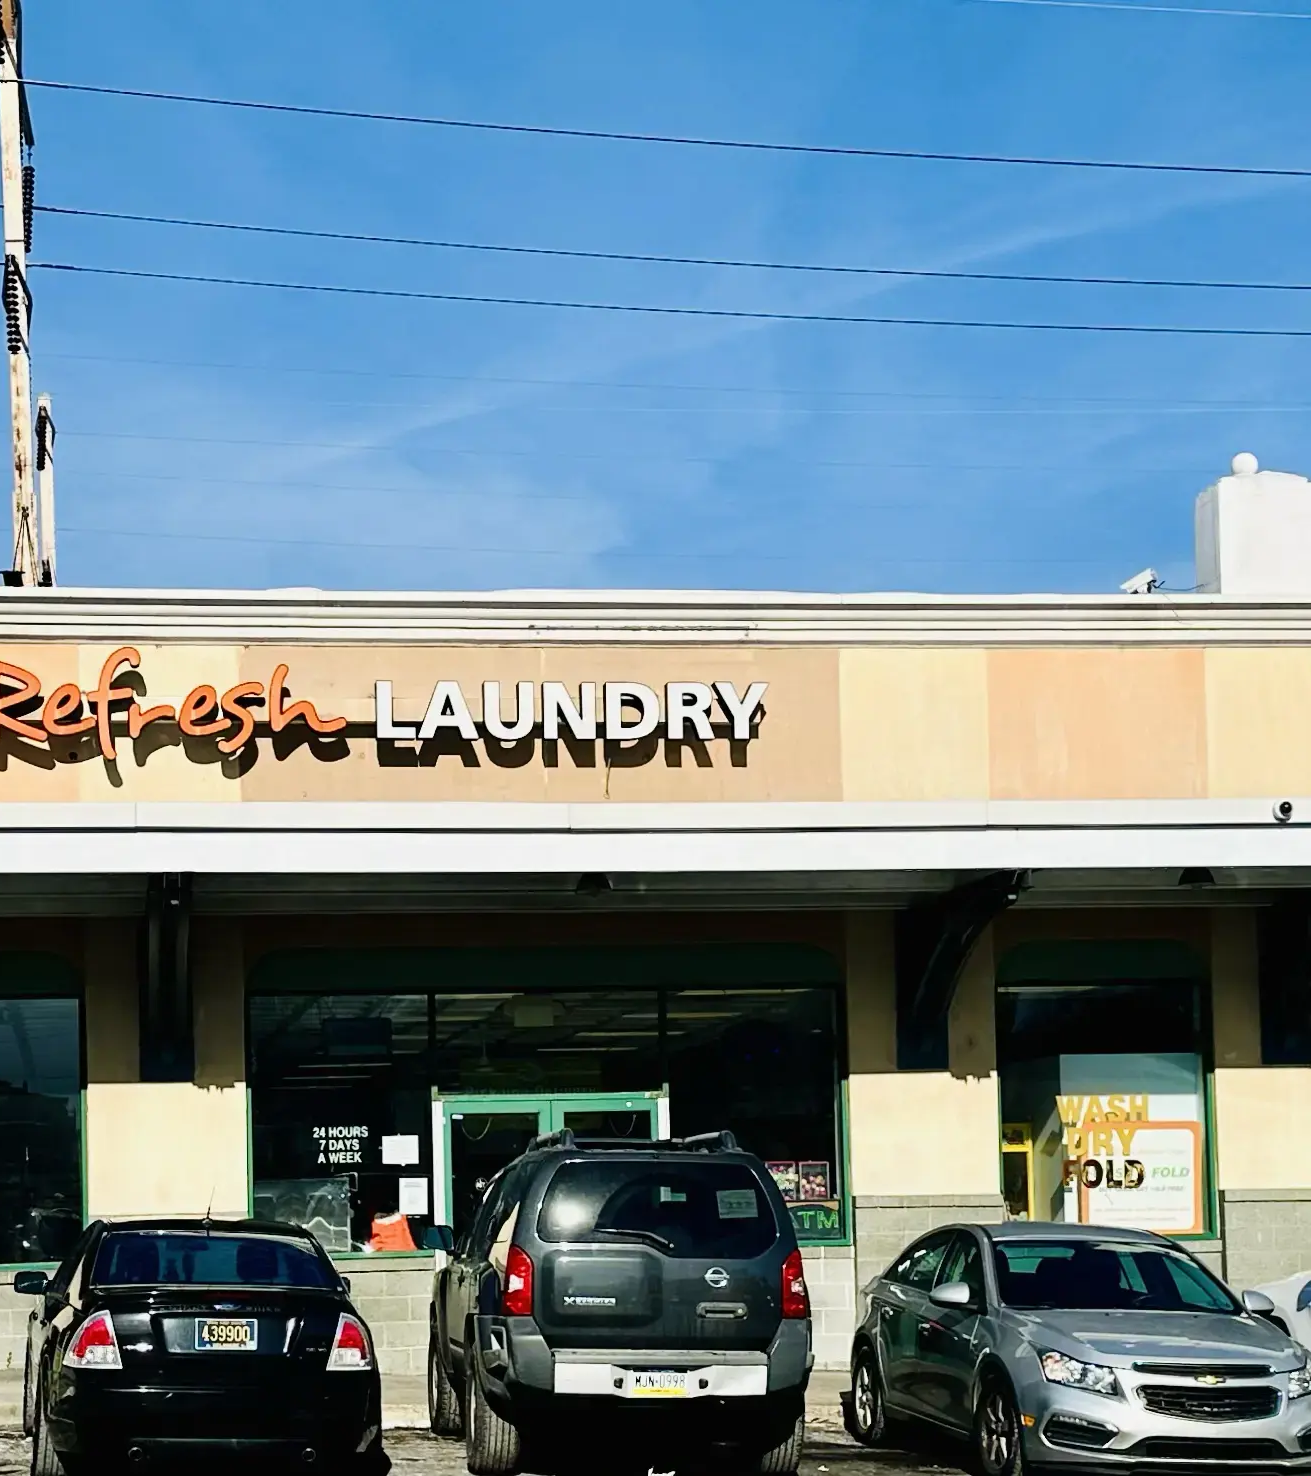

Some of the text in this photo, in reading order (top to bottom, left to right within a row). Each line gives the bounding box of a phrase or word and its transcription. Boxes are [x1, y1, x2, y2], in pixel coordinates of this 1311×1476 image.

[375, 680, 770, 740] LAUNDRY
[1055, 1094, 1149, 1125] WASH
[312, 1126, 369, 1138] 24 HOURS
[319, 1139, 360, 1150] 7 DAYS
[1067, 1126, 1137, 1156] DRY
[317, 1152, 362, 1164] A WEEK
[1063, 1159, 1145, 1189] FOLD
[1151, 1166, 1190, 1178] FOLD
[201, 1325, 250, 1342] 439900
